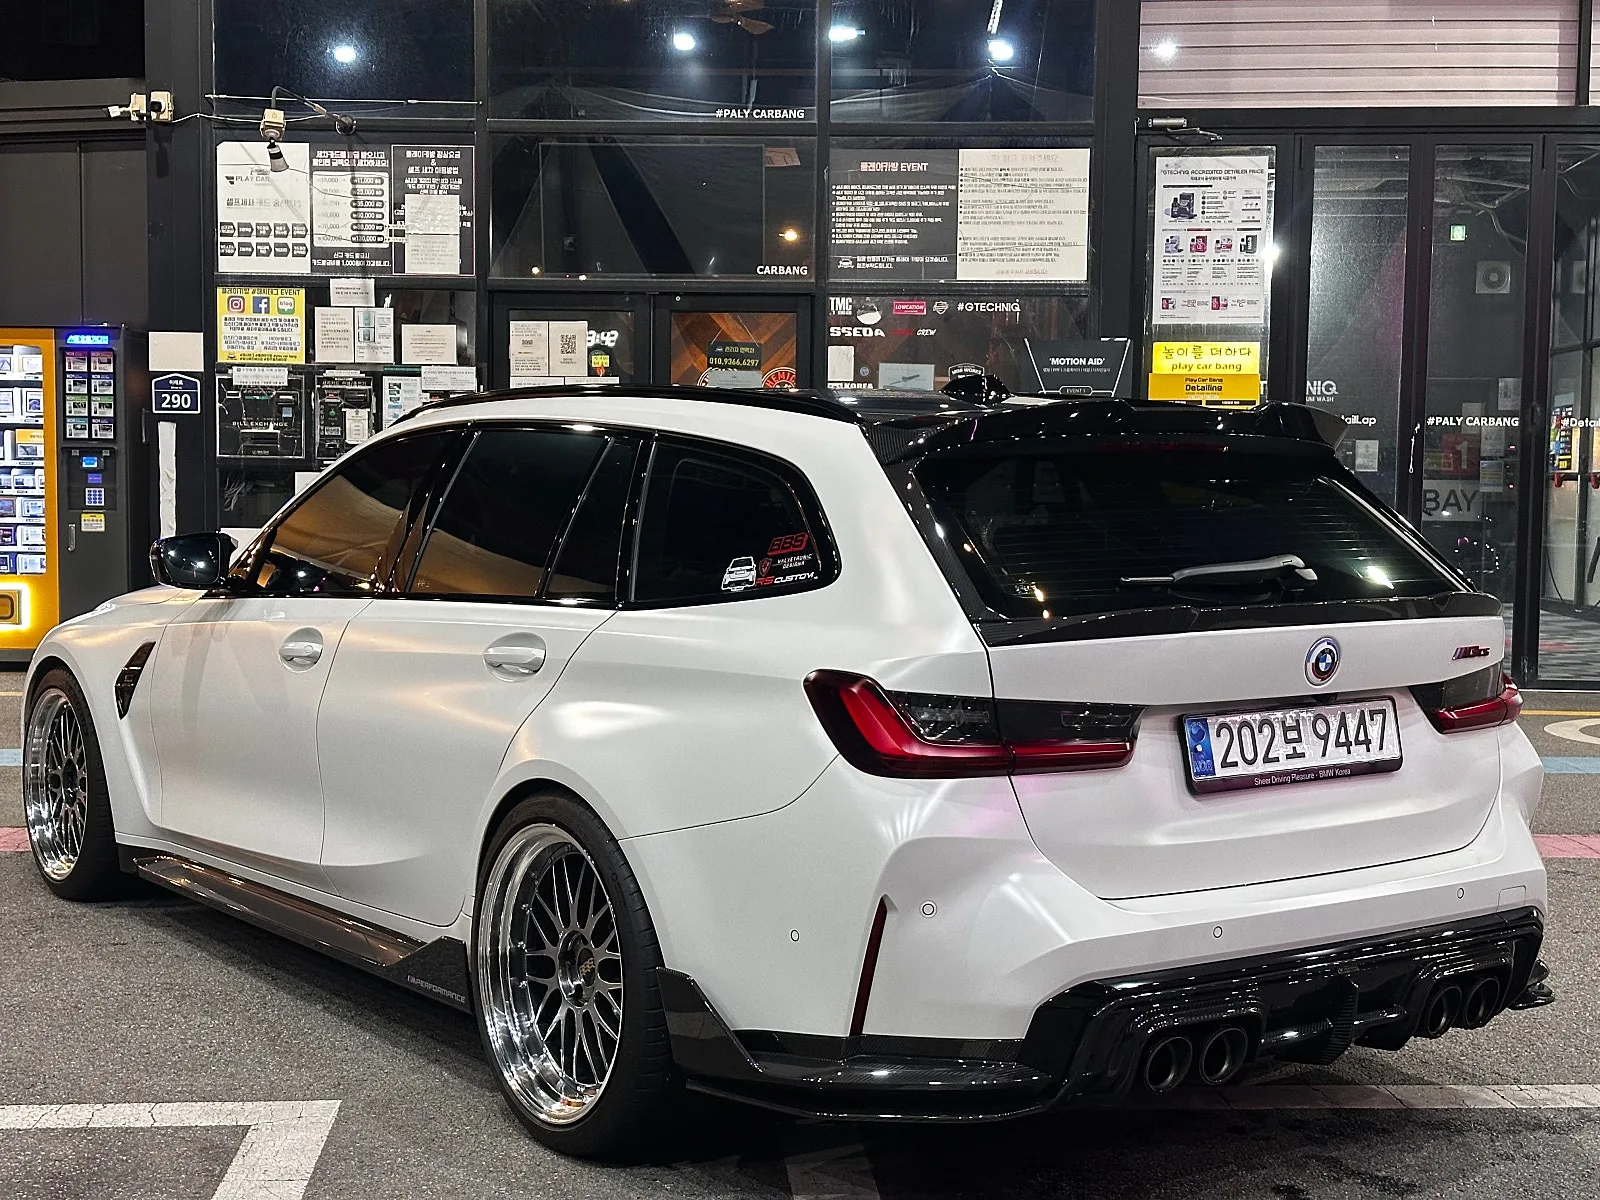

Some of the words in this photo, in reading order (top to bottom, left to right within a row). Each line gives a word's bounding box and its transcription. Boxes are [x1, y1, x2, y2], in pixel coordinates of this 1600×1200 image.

[715, 108, 751, 119] #PALY
[753, 108, 805, 119] CARBANG
[900, 162, 929, 172] EVENT
[756, 265, 808, 275] CARBANG
[280, 288, 300, 296] EVENT
[829, 297, 853, 311] TMC
[957, 302, 1021, 312] #GTECHNIQ
[1163, 345, 1203, 360] 놀이를
[1210, 347, 1252, 357] 더하다
[709, 357, 759, 366] 010.9366.6297
[1171, 362, 1194, 372] play
[1215, 362, 1242, 372] bang
[1185, 384, 1223, 392] Detailing
[161, 393, 191, 409] 290
[1426, 416, 1464, 427] #PALY
[1465, 416, 1520, 427] CARBANG
[1456, 440, 1469, 470] 1
[1422, 488, 1480, 513] BAY
[767, 531, 809, 556] BBS
[1216, 716, 1306, 769] 202보
[1311, 708, 1387, 758] 9447
[1254, 777, 1272, 786] Sheer
[1271, 774, 1291, 785] Driving
[1291, 772, 1315, 782] Pleasure
[1319, 769, 1334, 778] BMW
[1334, 768, 1351, 776] Korea
[414, 978, 466, 1004] PERFORMANCE
